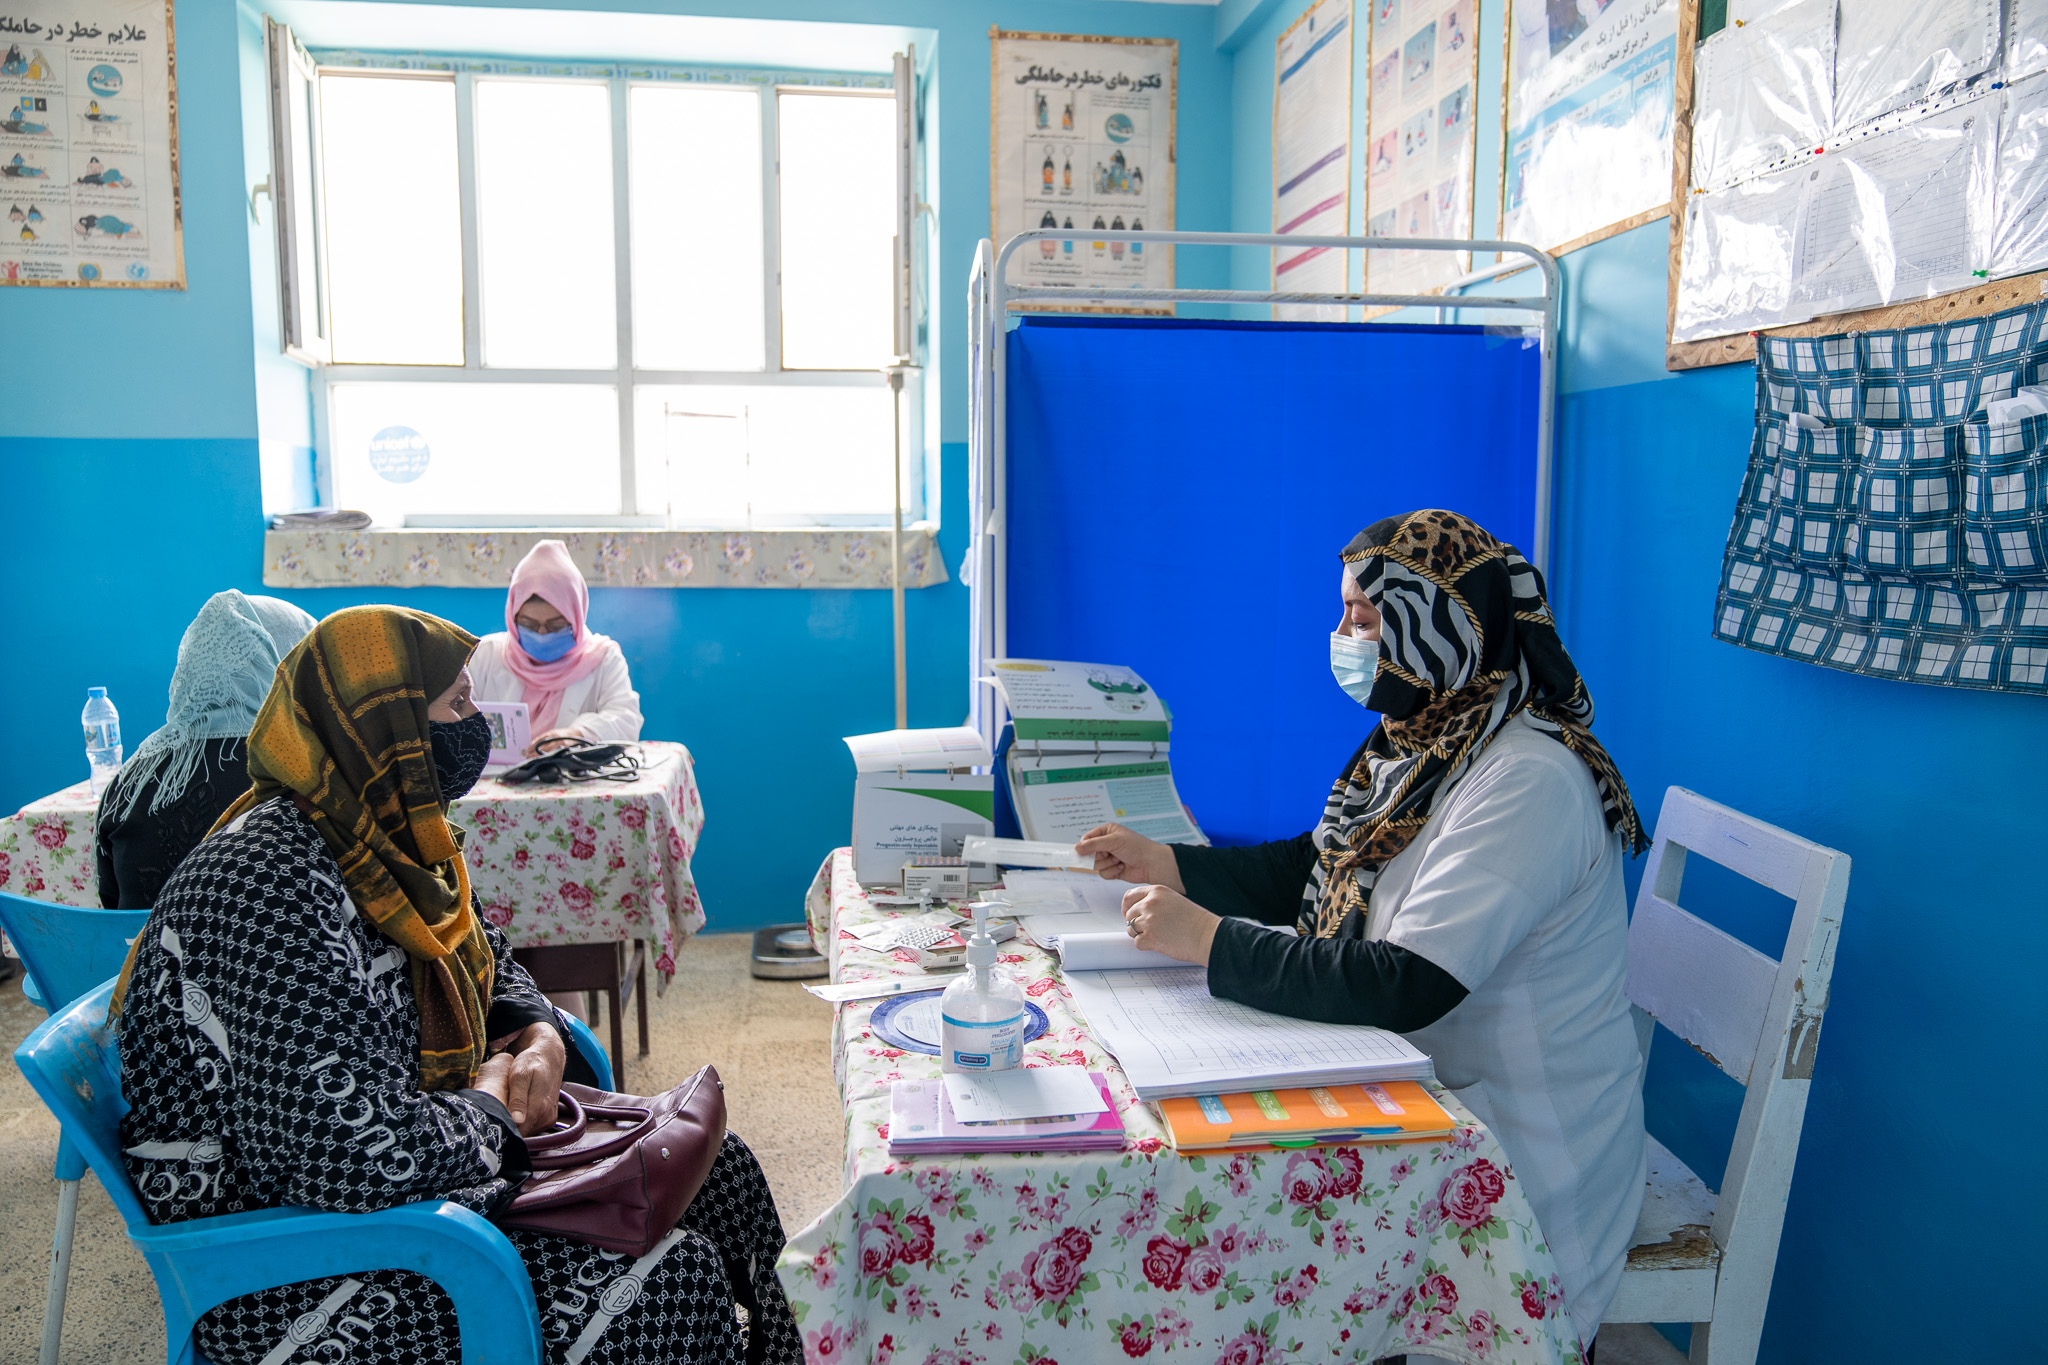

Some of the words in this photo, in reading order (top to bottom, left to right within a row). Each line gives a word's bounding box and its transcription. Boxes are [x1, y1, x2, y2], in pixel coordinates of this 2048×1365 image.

[44, 23, 64, 41] در
[66, 20, 103, 42] خطر
[107, 23, 147, 45] علایم
[1621, 39, 1639, 60] مرکز
[1600, 50, 1620, 70] صحی
[1015, 64, 1064, 84] حاملگی
[1063, 72, 1079, 88] در
[1075, 69, 1104, 89] خطر
[876, 842, 912, 850] Progestin-only
[308, 1052, 416, 1181] GUCCI
